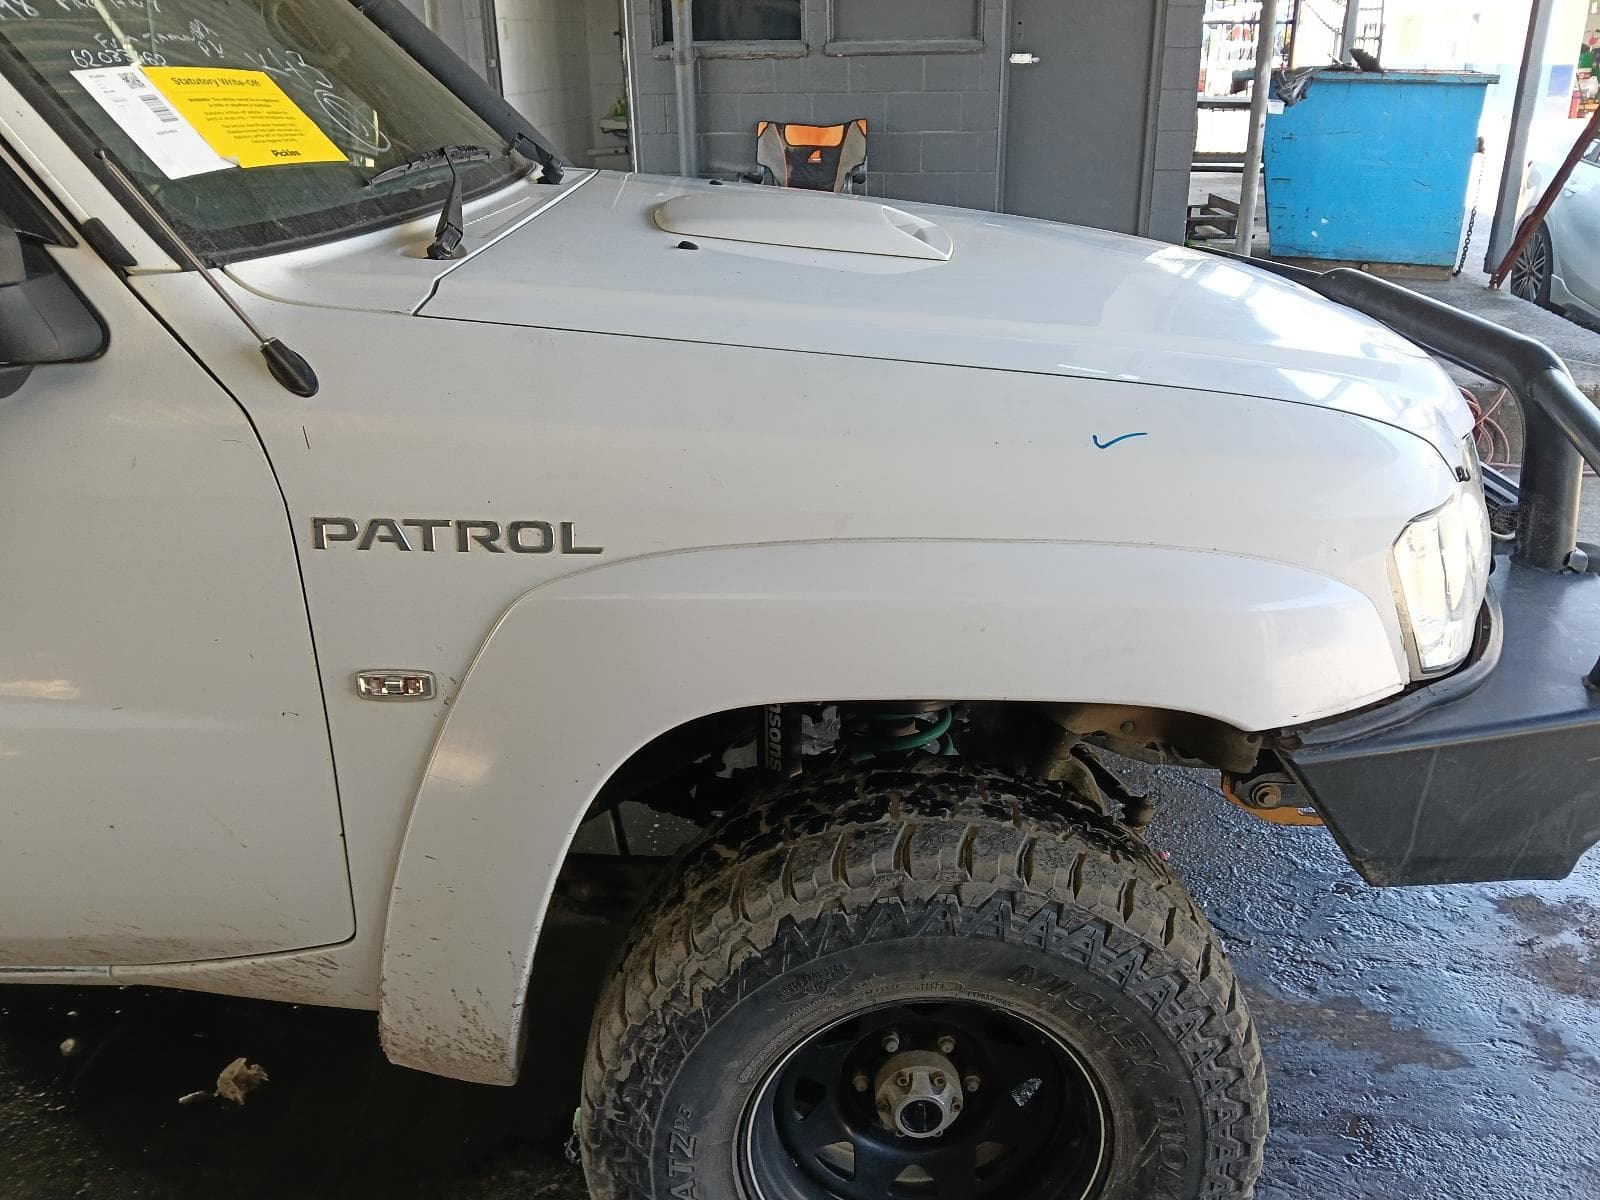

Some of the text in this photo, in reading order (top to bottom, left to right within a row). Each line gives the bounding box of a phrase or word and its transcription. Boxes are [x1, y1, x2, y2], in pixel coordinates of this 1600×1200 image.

[170, 77, 261, 88] Statutory Write-Off
[271, 148, 301, 158] Pickles
[311, 516, 604, 554] PATROL
